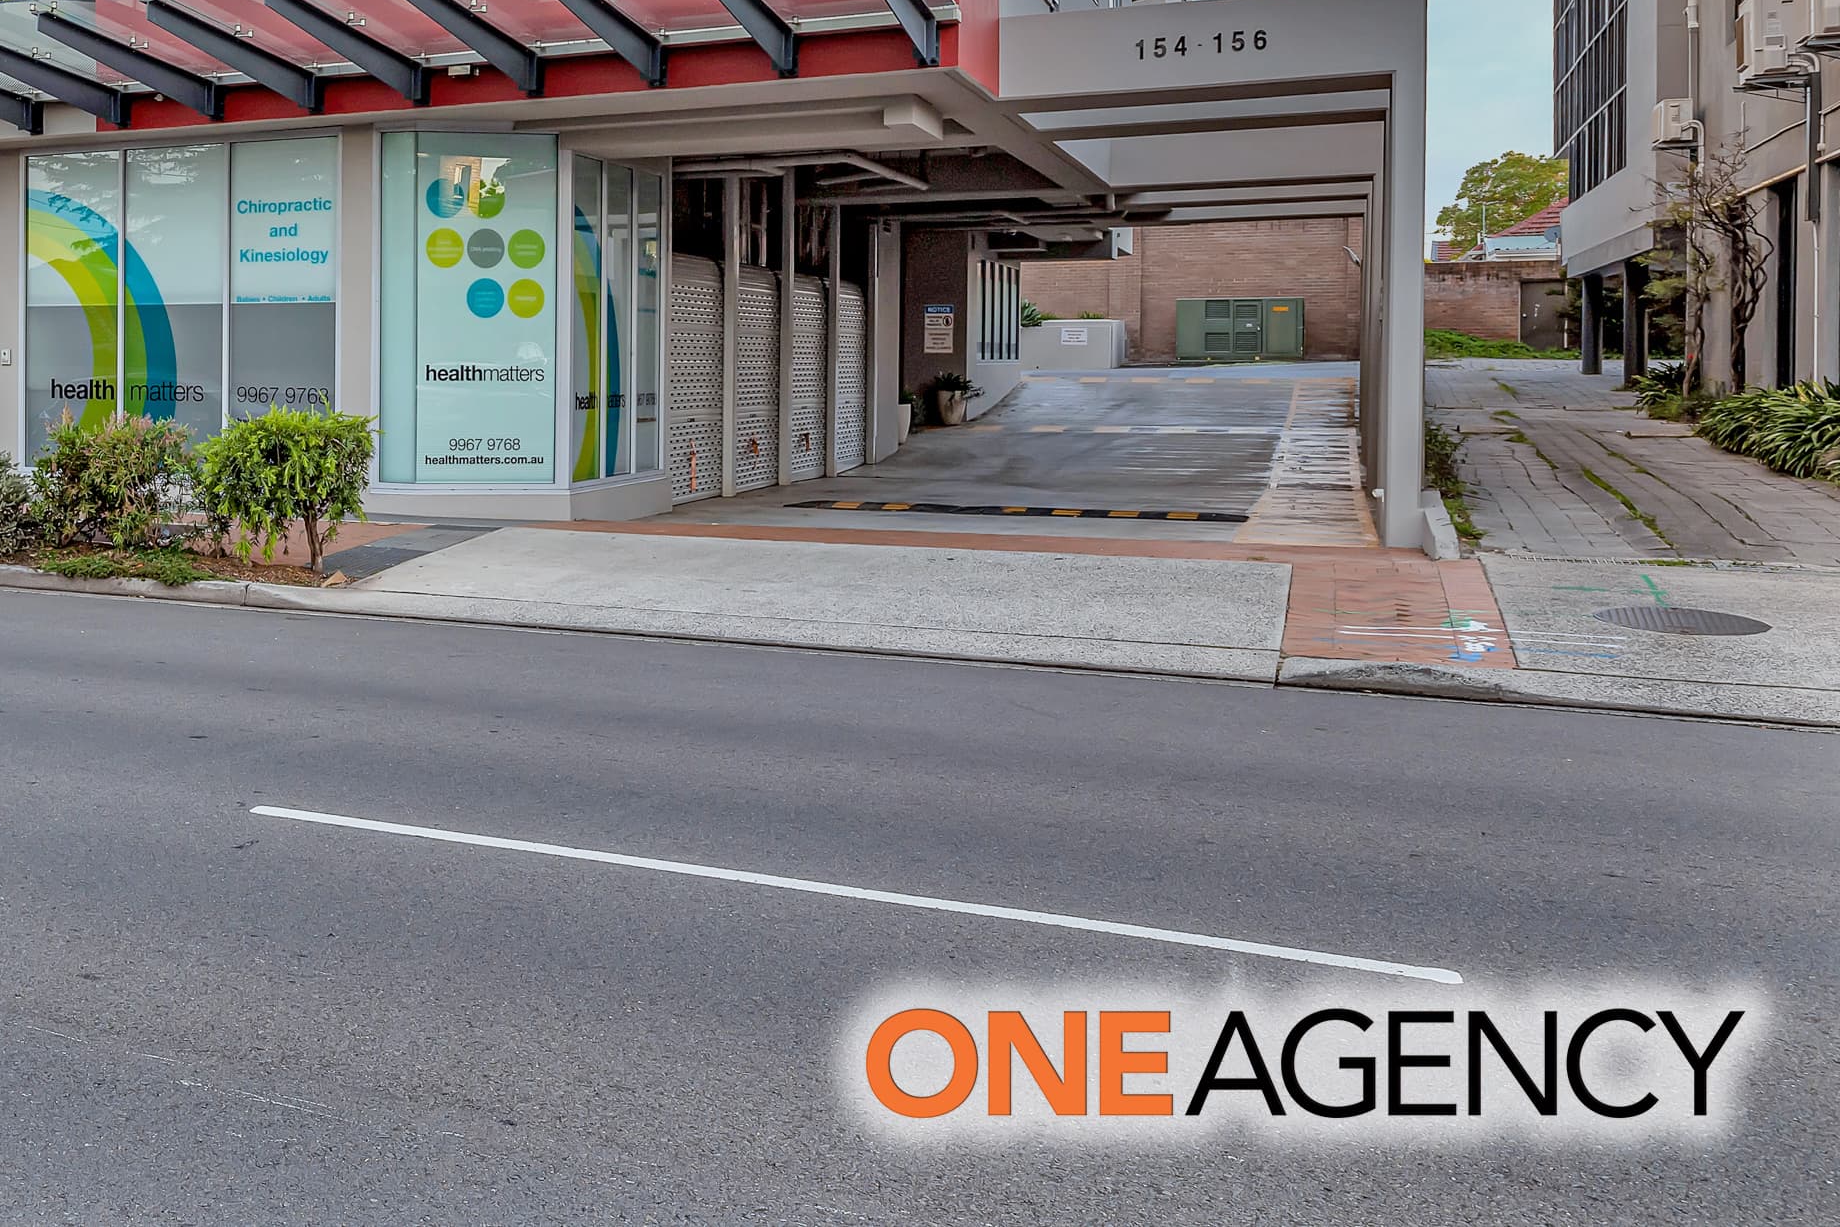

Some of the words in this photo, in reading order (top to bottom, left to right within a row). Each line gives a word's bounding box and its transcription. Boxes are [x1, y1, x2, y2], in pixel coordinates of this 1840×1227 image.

[237, 197, 333, 214] Chiropractic
[269, 222, 298, 237] and
[240, 248, 329, 264] Kinesiology
[425, 364, 545, 382] healthmatters
[237, 386, 279, 405] 9967
[285, 387, 329, 405] 9768
[449, 438, 482, 451] 9967
[487, 438, 521, 451] 9768
[424, 455, 545, 465] healthmatters.com.au
